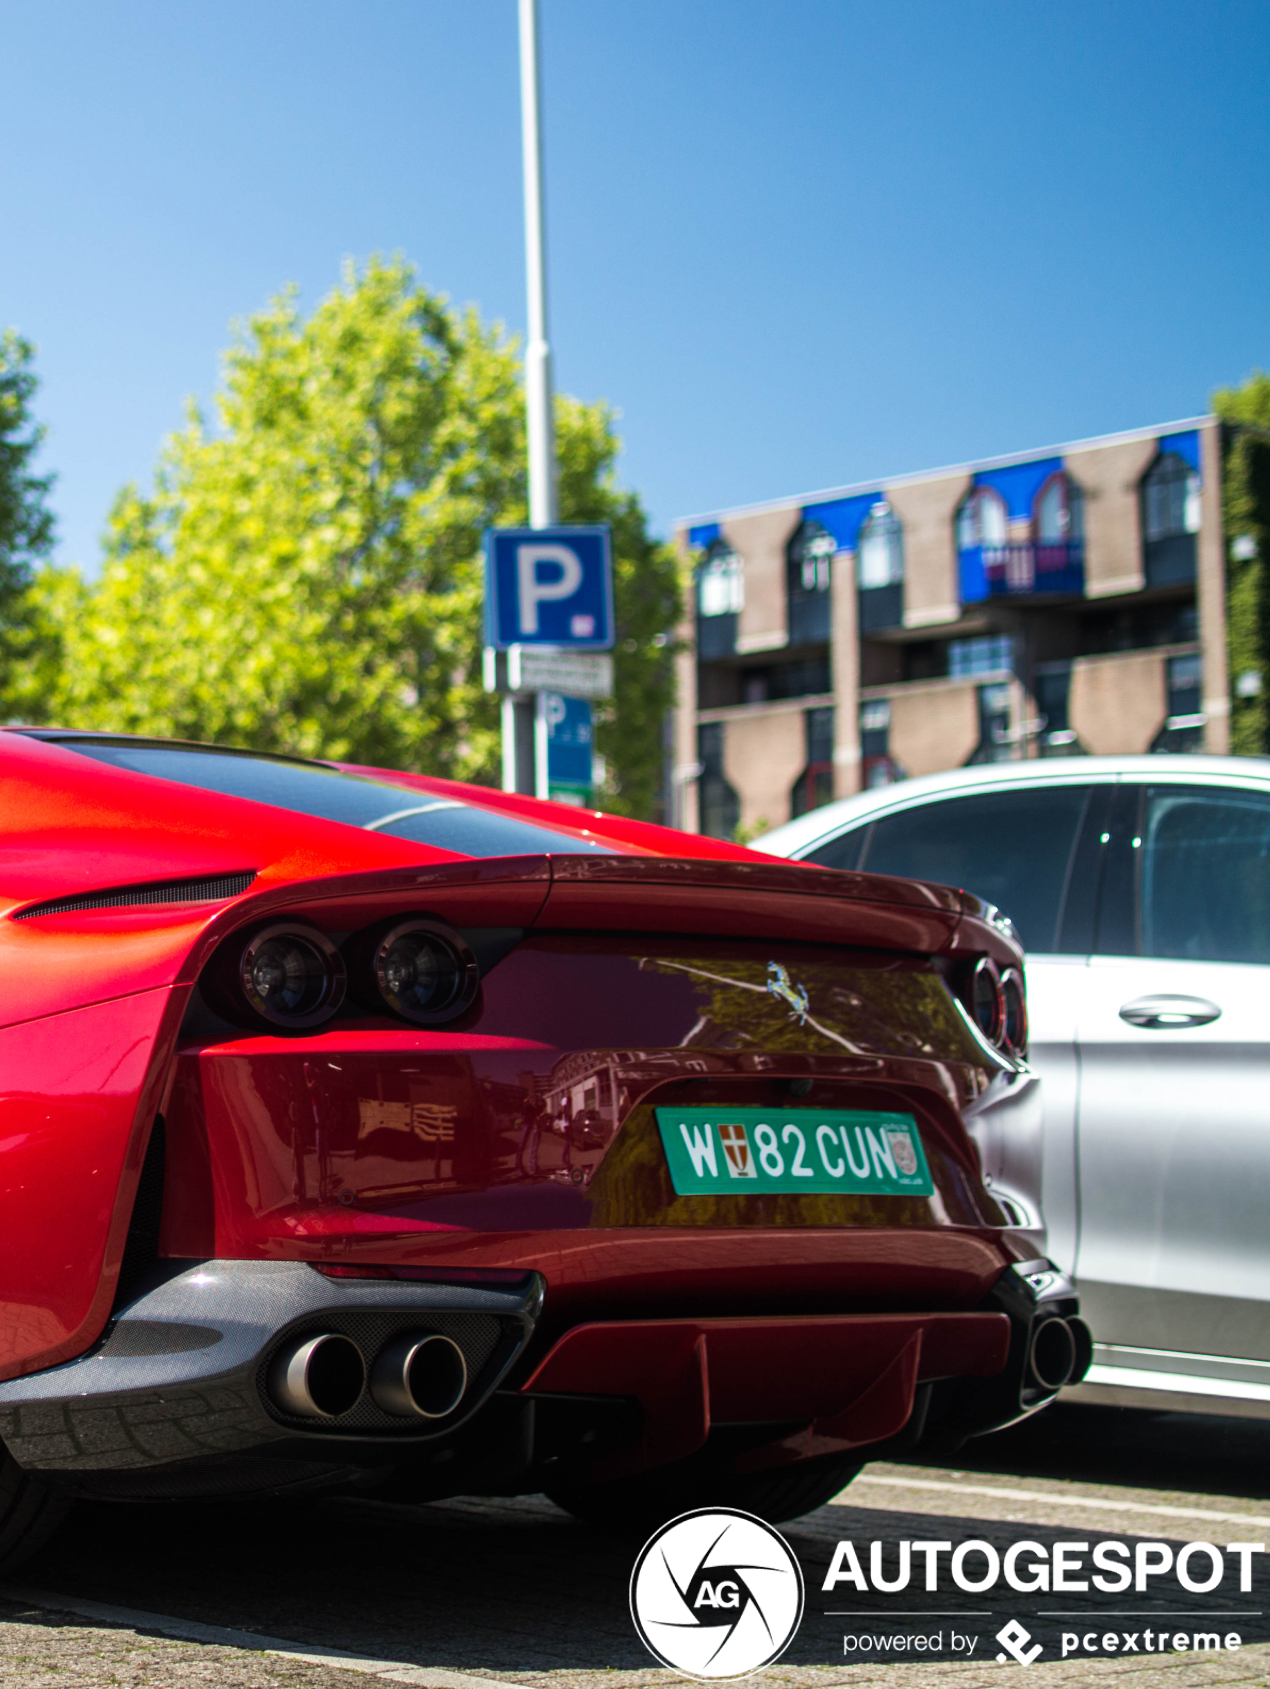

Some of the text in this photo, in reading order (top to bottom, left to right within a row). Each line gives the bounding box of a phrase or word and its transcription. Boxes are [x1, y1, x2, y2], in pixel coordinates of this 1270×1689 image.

[517, 543, 583, 635] P
[679, 1123, 898, 1179] W 82 CUN
